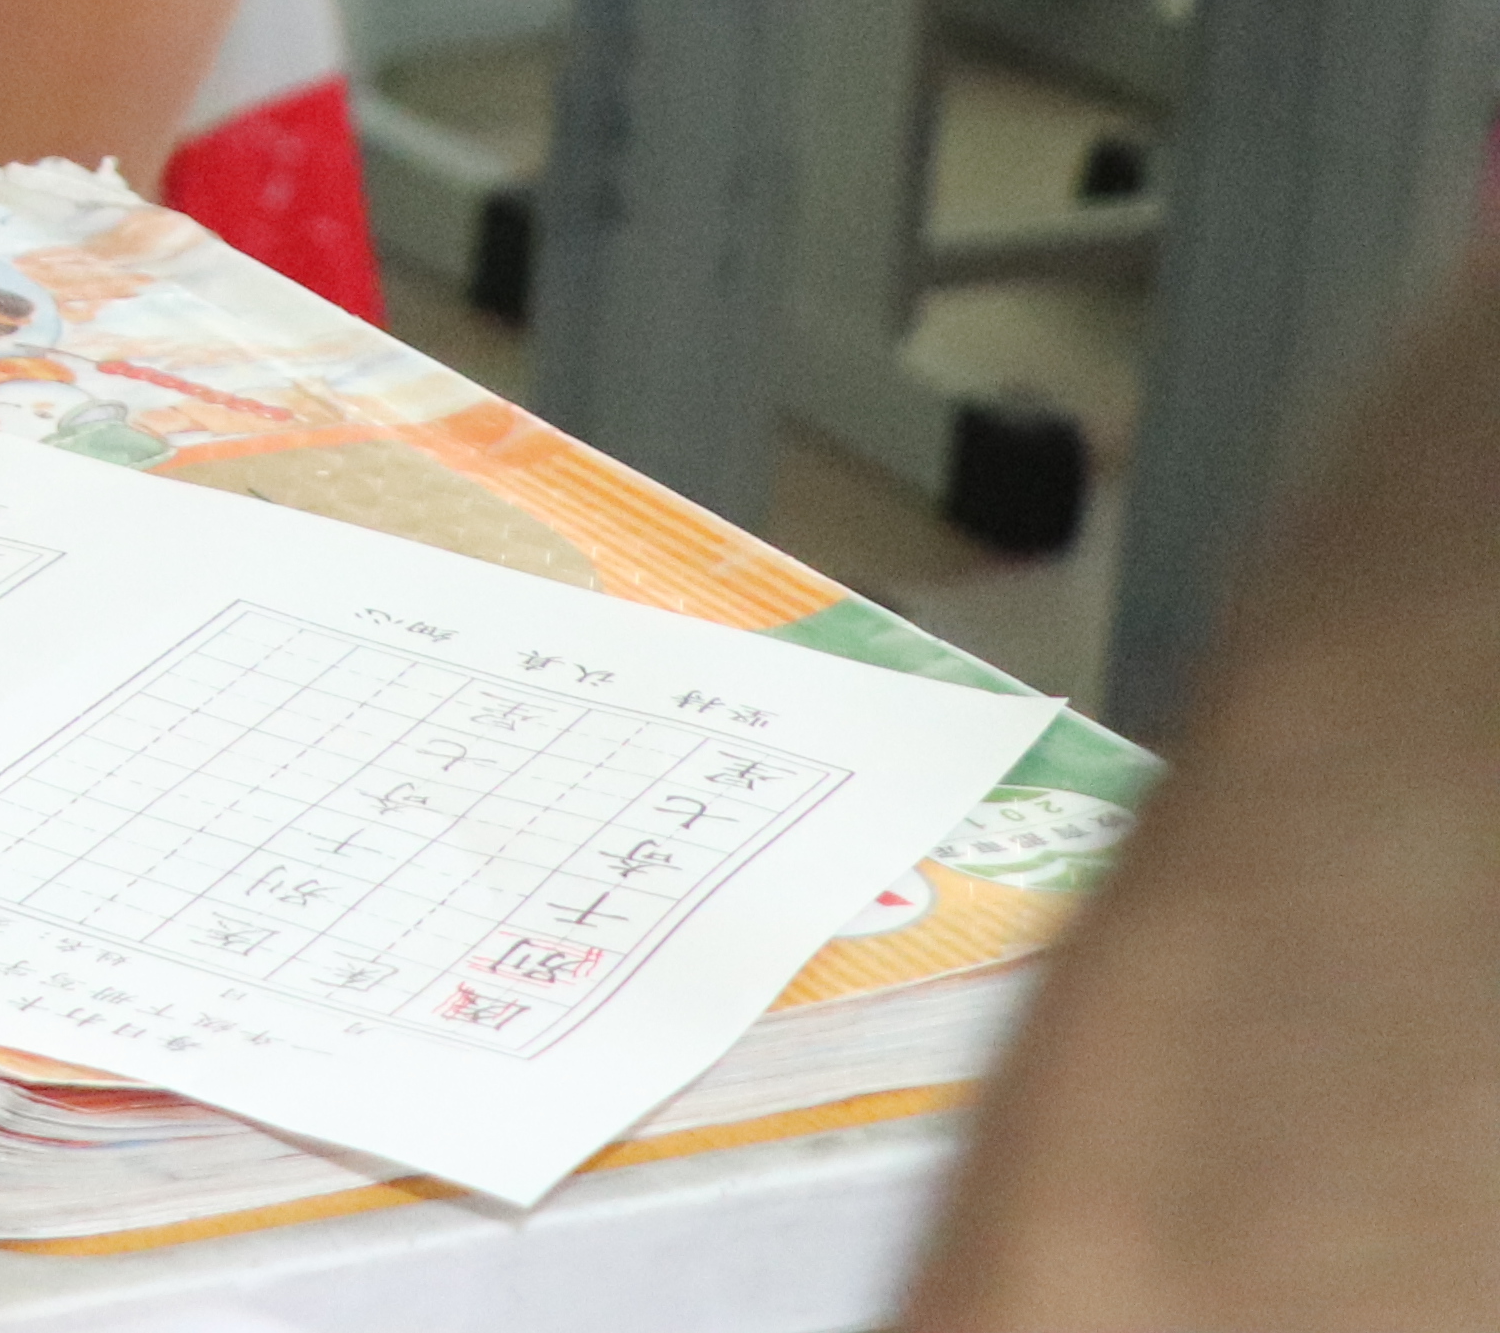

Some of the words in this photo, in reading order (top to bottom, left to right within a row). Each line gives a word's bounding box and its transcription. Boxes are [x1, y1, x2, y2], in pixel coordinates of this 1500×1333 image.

[354, 607, 459, 644] 细心
[517, 650, 614, 687] 认真
[671, 690, 778, 728] 坚持
[189, 912, 279, 957] 医
[245, 865, 337, 908] 别
[354, 782, 429, 816] 奇
[416, 739, 496, 771] 七
[470, 690, 558, 731] 星
[964, 800, 1062, 830] 201
[487, 939, 579, 983] 别
[546, 891, 629, 929] 干
[599, 840, 681, 878] 奇
[653, 795, 738, 830] 七
[704, 751, 798, 790] 星
[309, 951, 399, 993] 医
[8, 995, 200, 1052] 每日打卡
